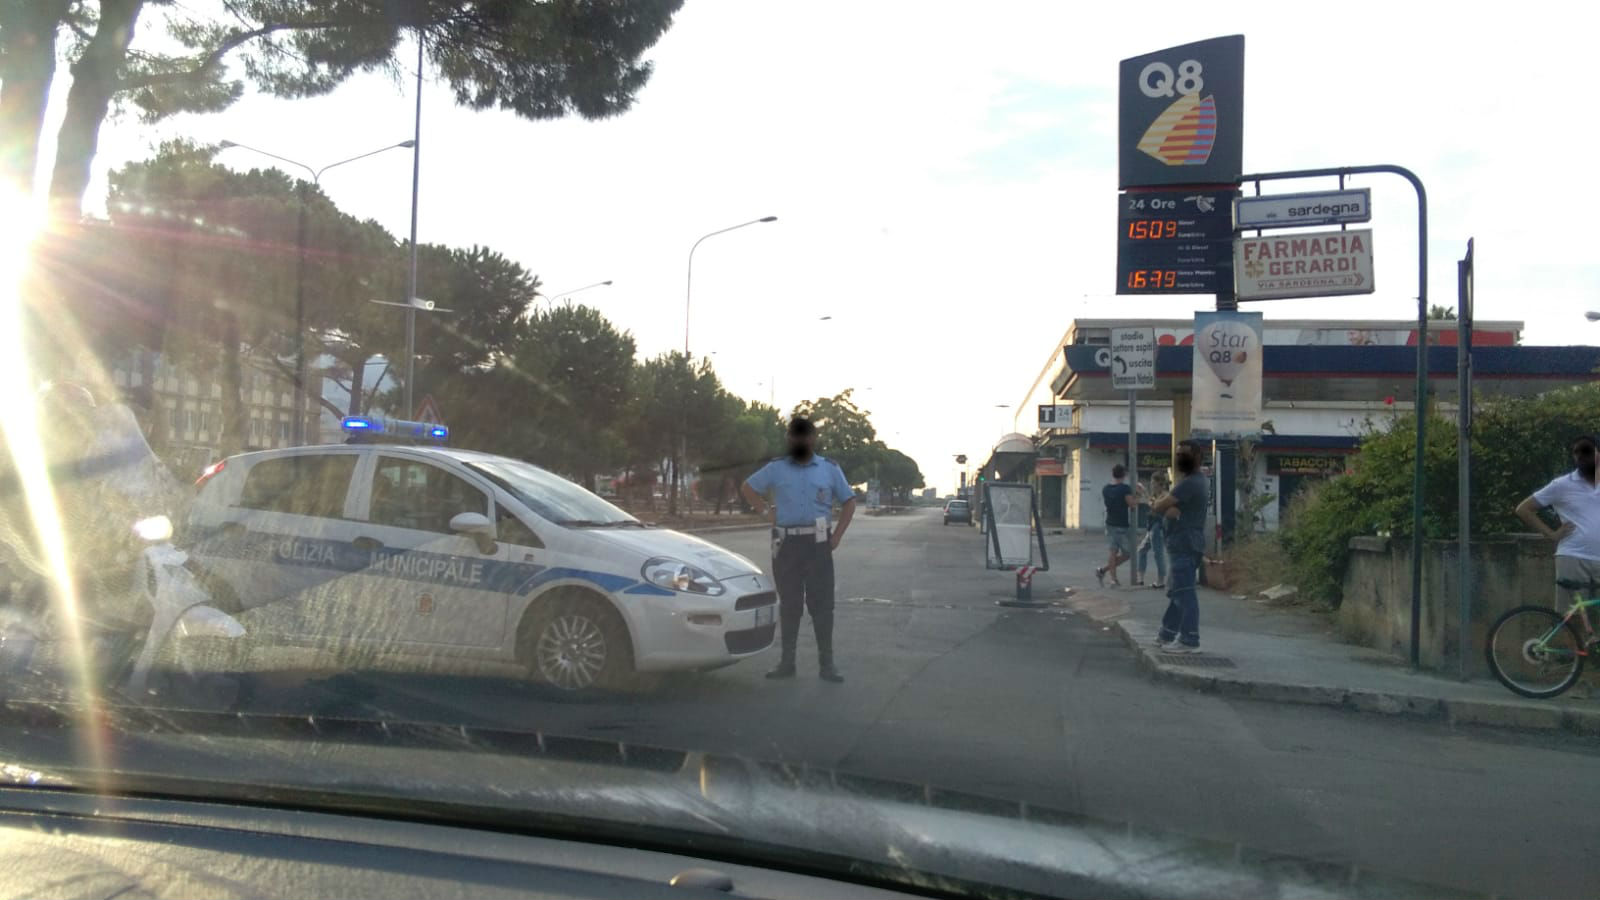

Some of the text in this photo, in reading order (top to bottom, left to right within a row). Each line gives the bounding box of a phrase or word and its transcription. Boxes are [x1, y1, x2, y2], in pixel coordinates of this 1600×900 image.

[1138, 59, 1204, 98] Q8
[1128, 199, 1176, 209] 24 Ore
[1288, 202, 1360, 217] sardegna
[1243, 235, 1365, 260] FARMACIA
[1269, 257, 1357, 276] GERARDI
[1120, 331, 1144, 341] stadio
[1210, 330, 1248, 348] Star
[1095, 347, 1111, 367] Q
[1129, 358, 1153, 368] uscita
[1209, 350, 1231, 364] Q8
[1041, 407, 1053, 421] T
[269, 540, 484, 583] POLIZIA MUNICIPALE
